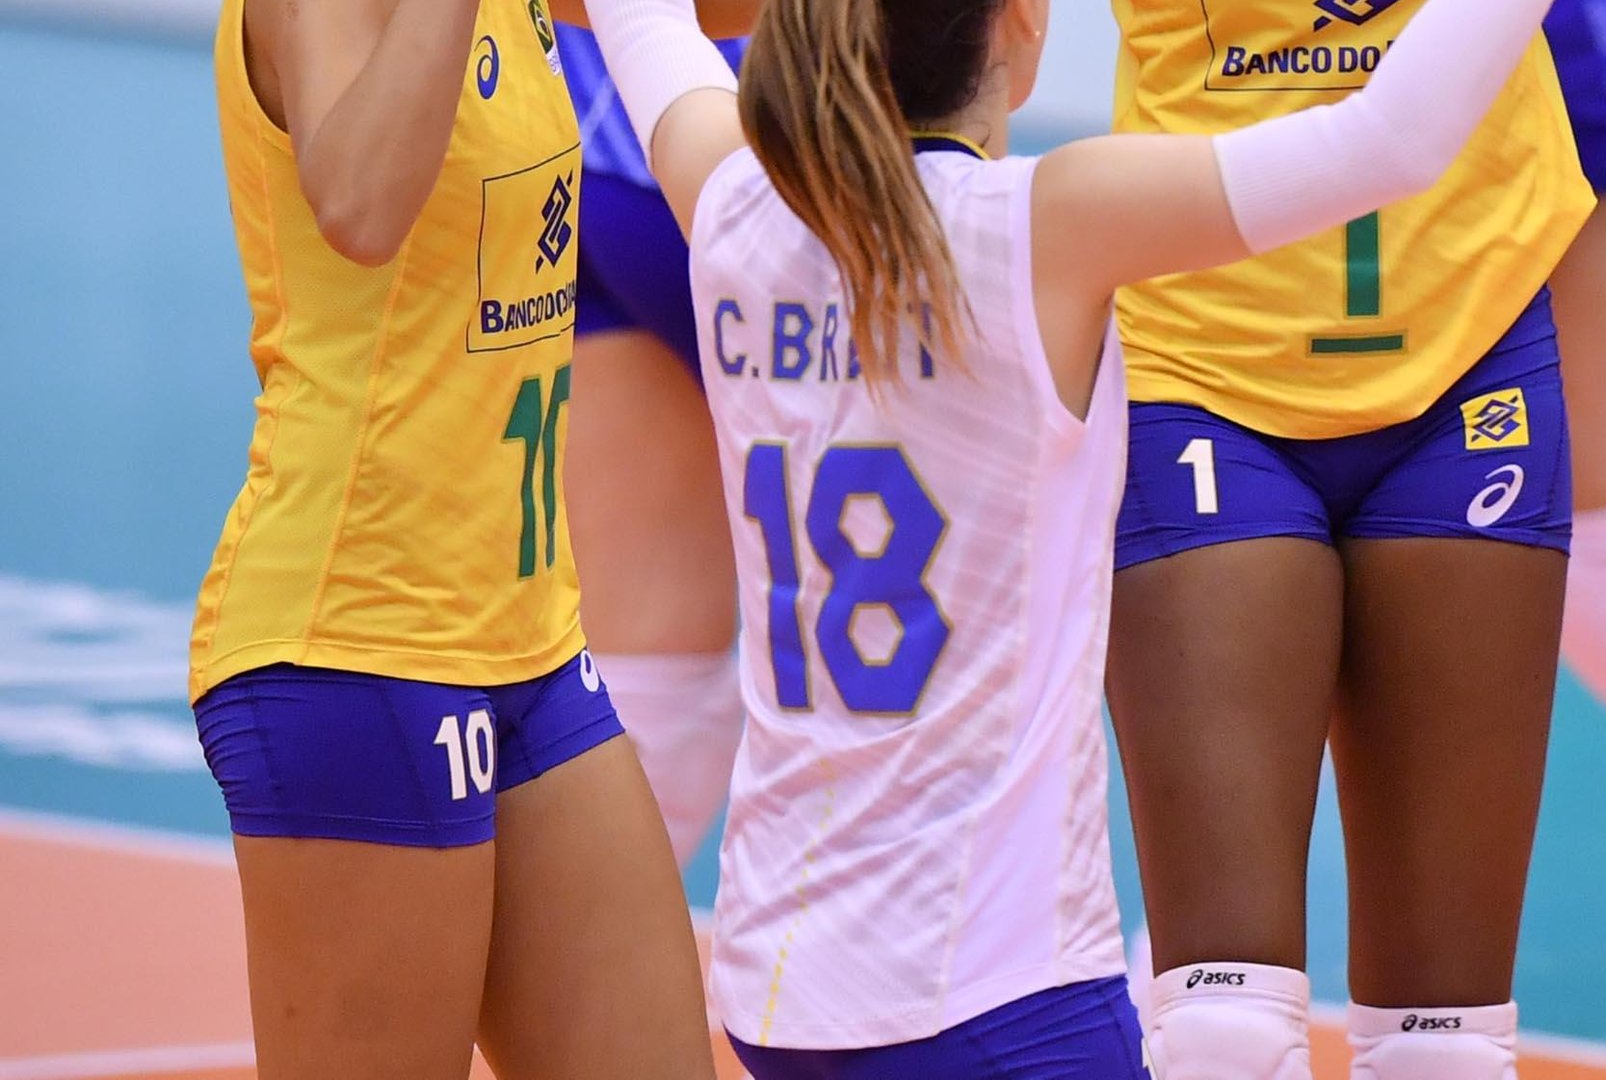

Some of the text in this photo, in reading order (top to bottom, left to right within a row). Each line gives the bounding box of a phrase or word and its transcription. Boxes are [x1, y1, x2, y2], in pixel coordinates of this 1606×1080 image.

[1221, 46, 1381, 77] BANCO DO
[480, 294, 544, 334] BANCO
[1176, 437, 1219, 515] 1
[743, 439, 955, 718] 18
[433, 708, 495, 801] 10
[1203, 972, 1246, 986] asics
[1418, 1016, 1462, 1030] asics
